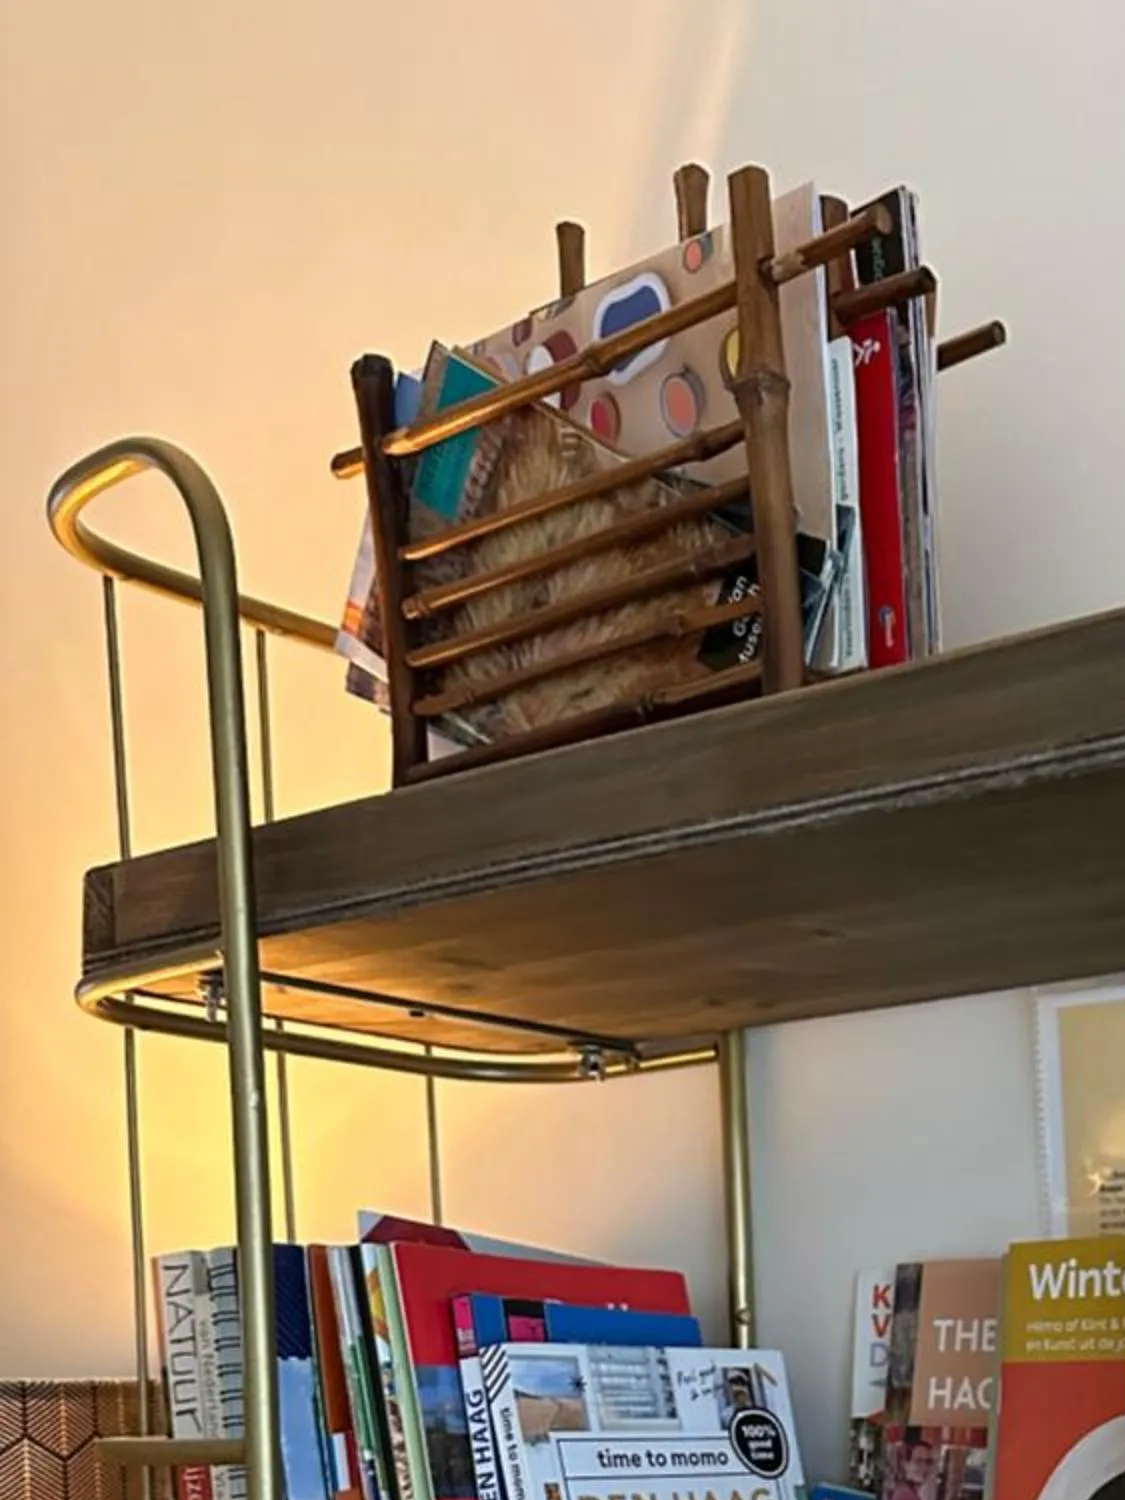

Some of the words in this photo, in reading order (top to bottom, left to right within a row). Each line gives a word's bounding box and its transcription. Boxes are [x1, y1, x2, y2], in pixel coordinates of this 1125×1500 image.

[872, 1283, 891, 1310] K
[871, 1313, 892, 1339] V
[932, 1317, 998, 1353] THE
[466, 1388, 494, 1465] HAAG
[499, 1406, 514, 1441] time
[596, 1448, 642, 1469] time
[645, 1450, 668, 1469] to
[671, 1449, 730, 1467] momo
